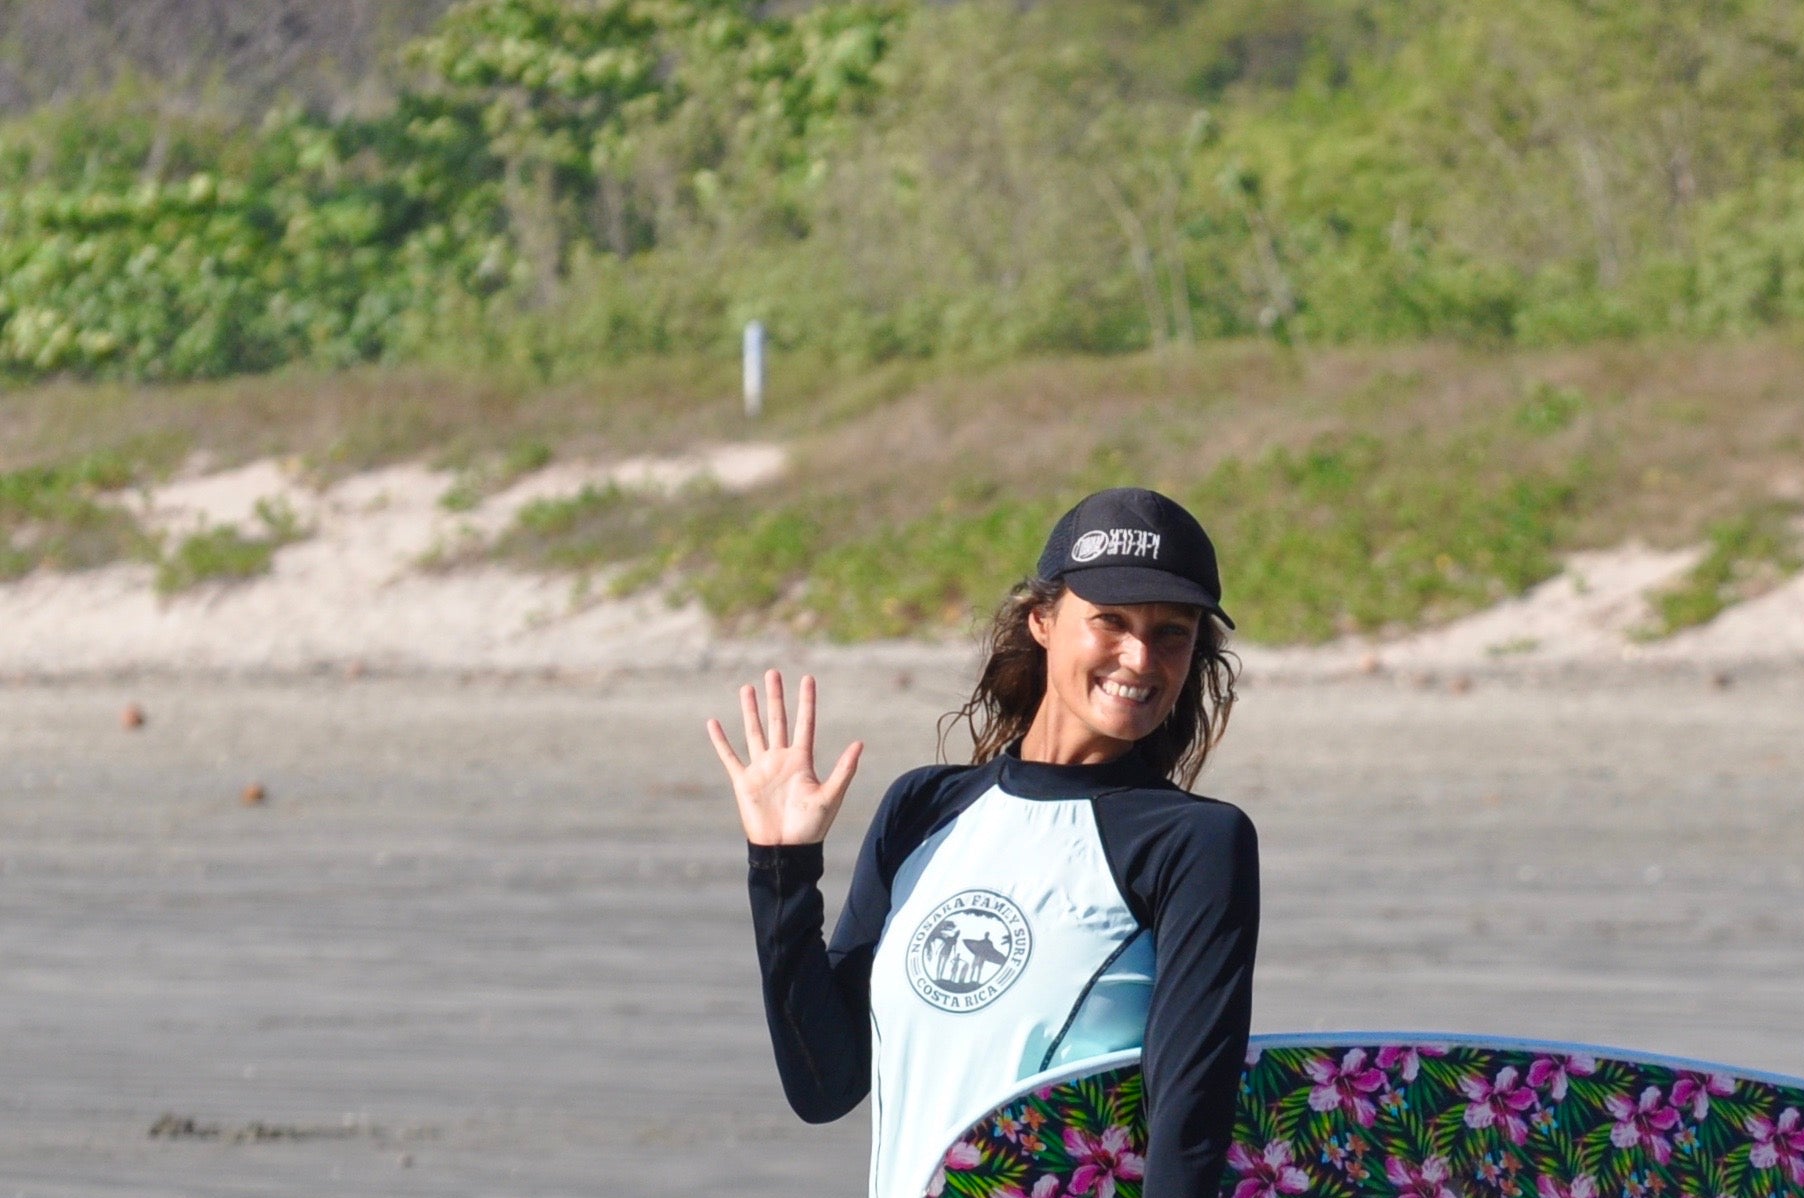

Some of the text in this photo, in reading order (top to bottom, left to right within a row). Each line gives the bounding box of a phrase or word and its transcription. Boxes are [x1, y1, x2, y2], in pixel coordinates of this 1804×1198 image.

[911, 895, 1027, 967] NOSARA FAMILY SURF
[916, 977, 998, 1008] COSTA RICA
